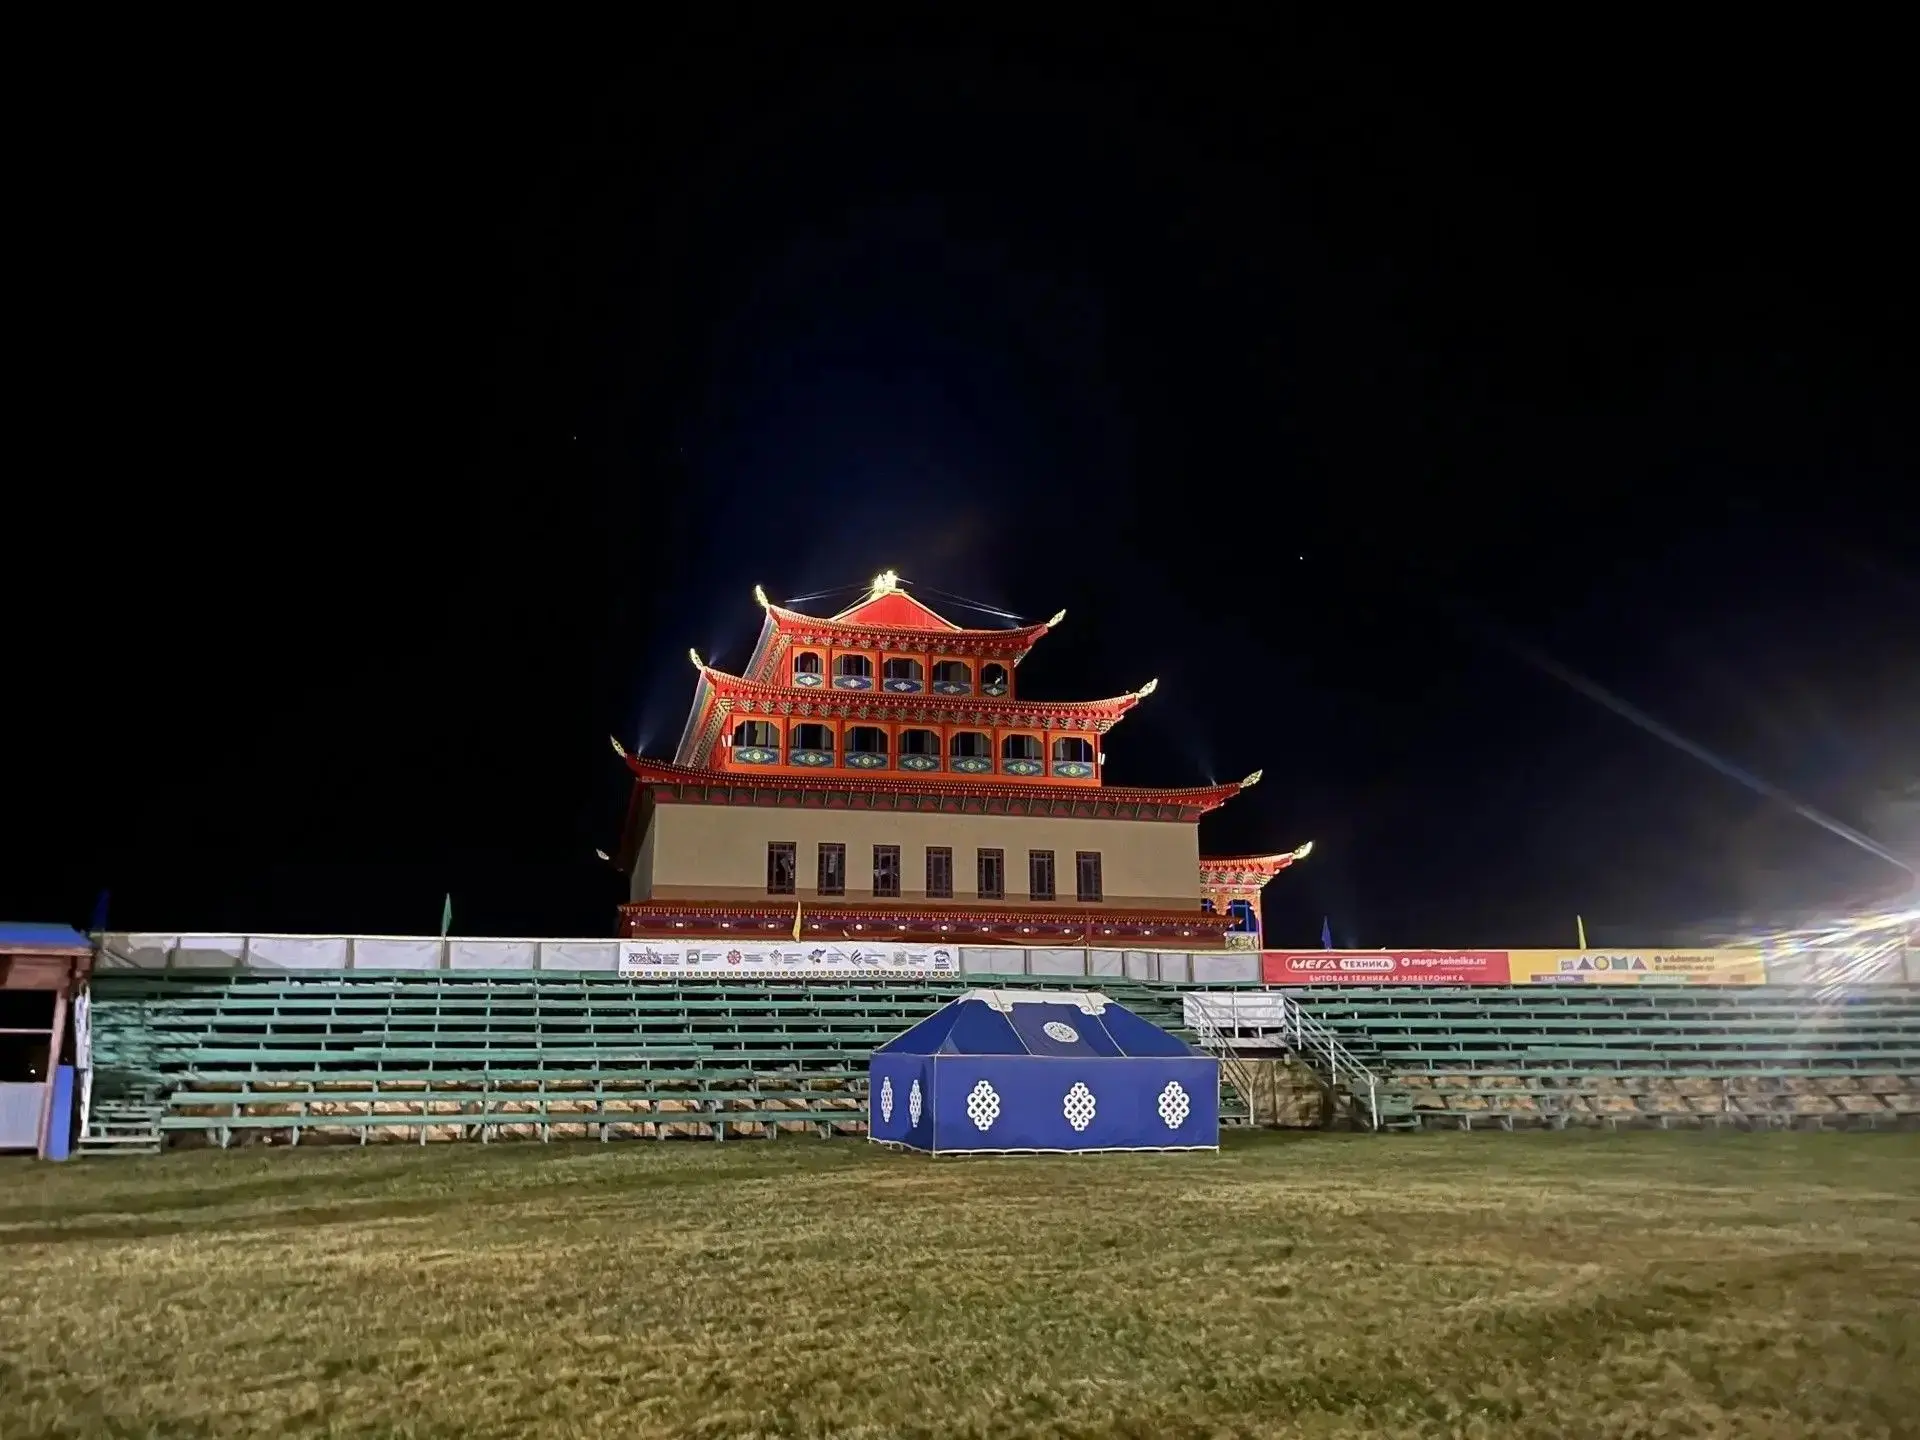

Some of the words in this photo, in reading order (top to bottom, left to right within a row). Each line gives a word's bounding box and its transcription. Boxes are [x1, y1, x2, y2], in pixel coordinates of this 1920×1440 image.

[1291, 959, 1337, 969] МЕГА
[1344, 960, 1390, 969] ТЕХНИКА
[1412, 956, 1487, 967] mega-tehnika.ru
